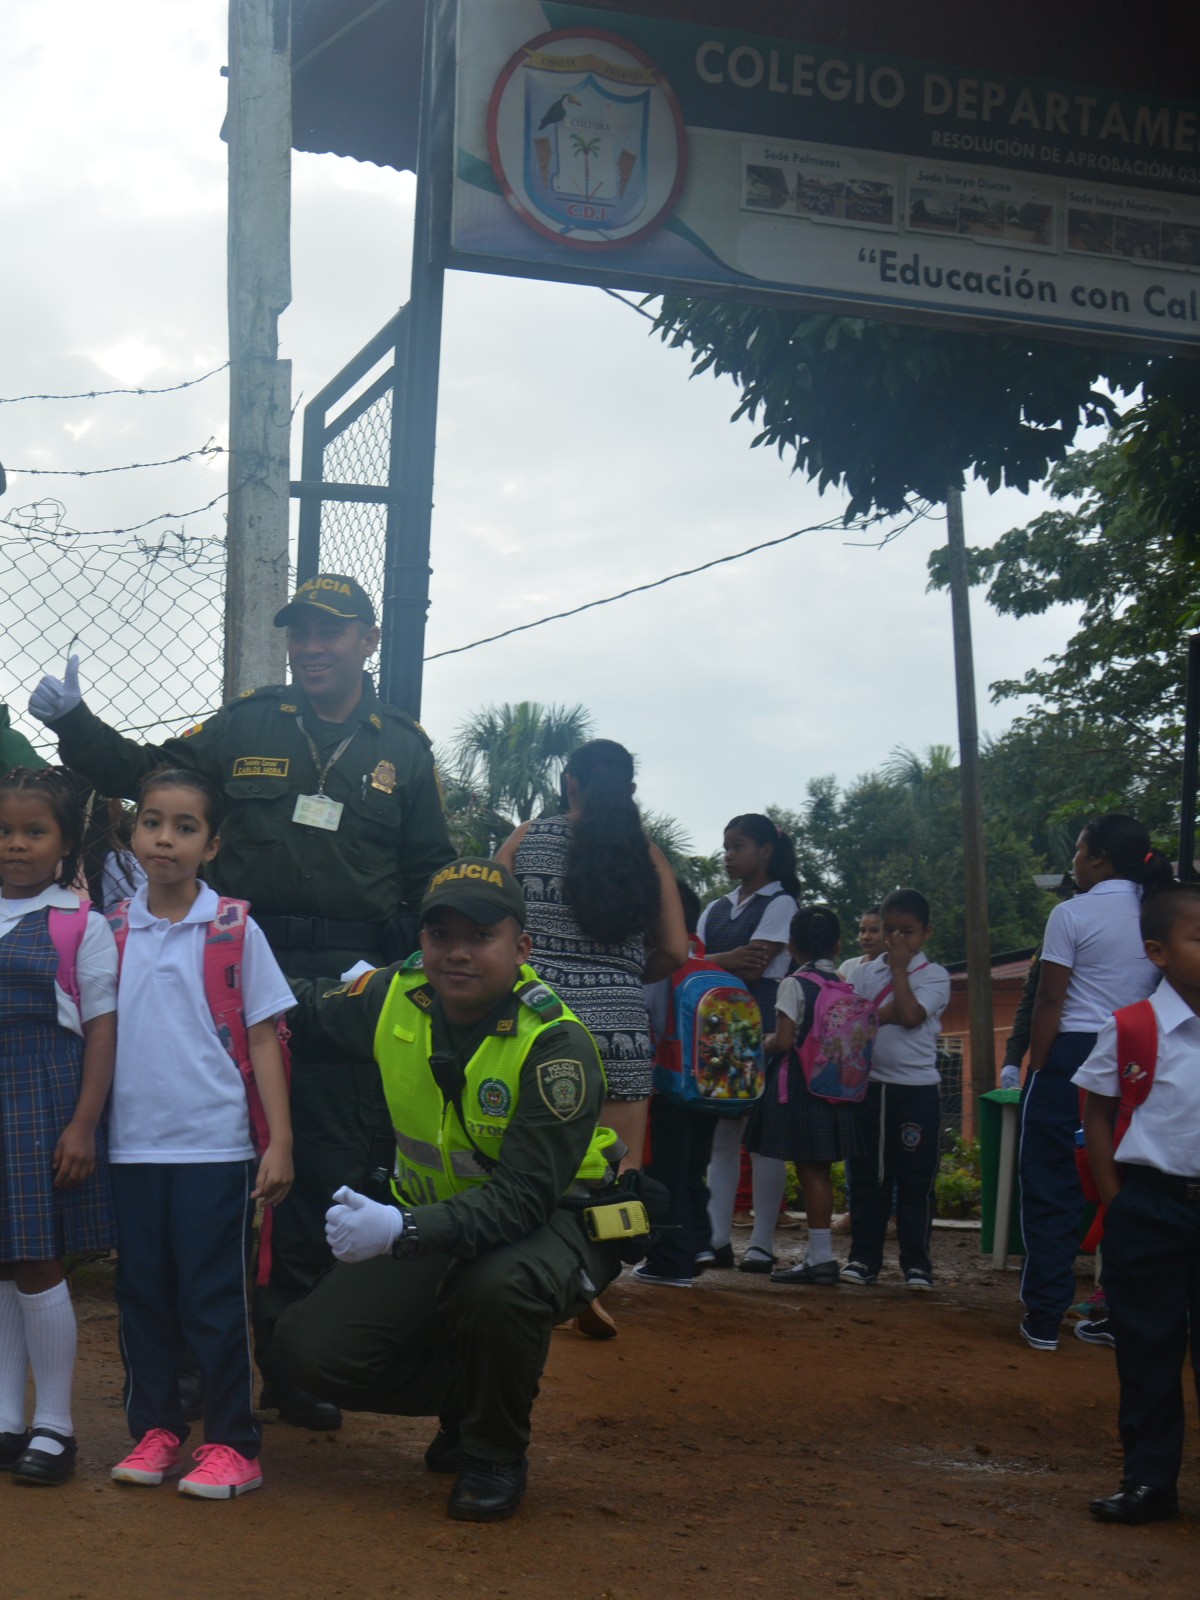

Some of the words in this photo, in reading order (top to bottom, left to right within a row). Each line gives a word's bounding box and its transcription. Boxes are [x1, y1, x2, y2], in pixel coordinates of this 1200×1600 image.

[695, 40, 906, 109] COLEGIO
[922, 72, 1200, 154] DEPARTAME
[764, 148, 789, 162] Sede
[792, 152, 841, 169] Palmeras
[931, 130, 1036, 160] RESOLUCIÓN
[1040, 145, 1061, 163] DE
[1065, 150, 1173, 180] APROBACIÓN
[917, 170, 943, 184] Sede
[1070, 285, 1130, 313] con
[1144, 284, 1197, 321] Cal
[429, 863, 504, 893] POLICIA
